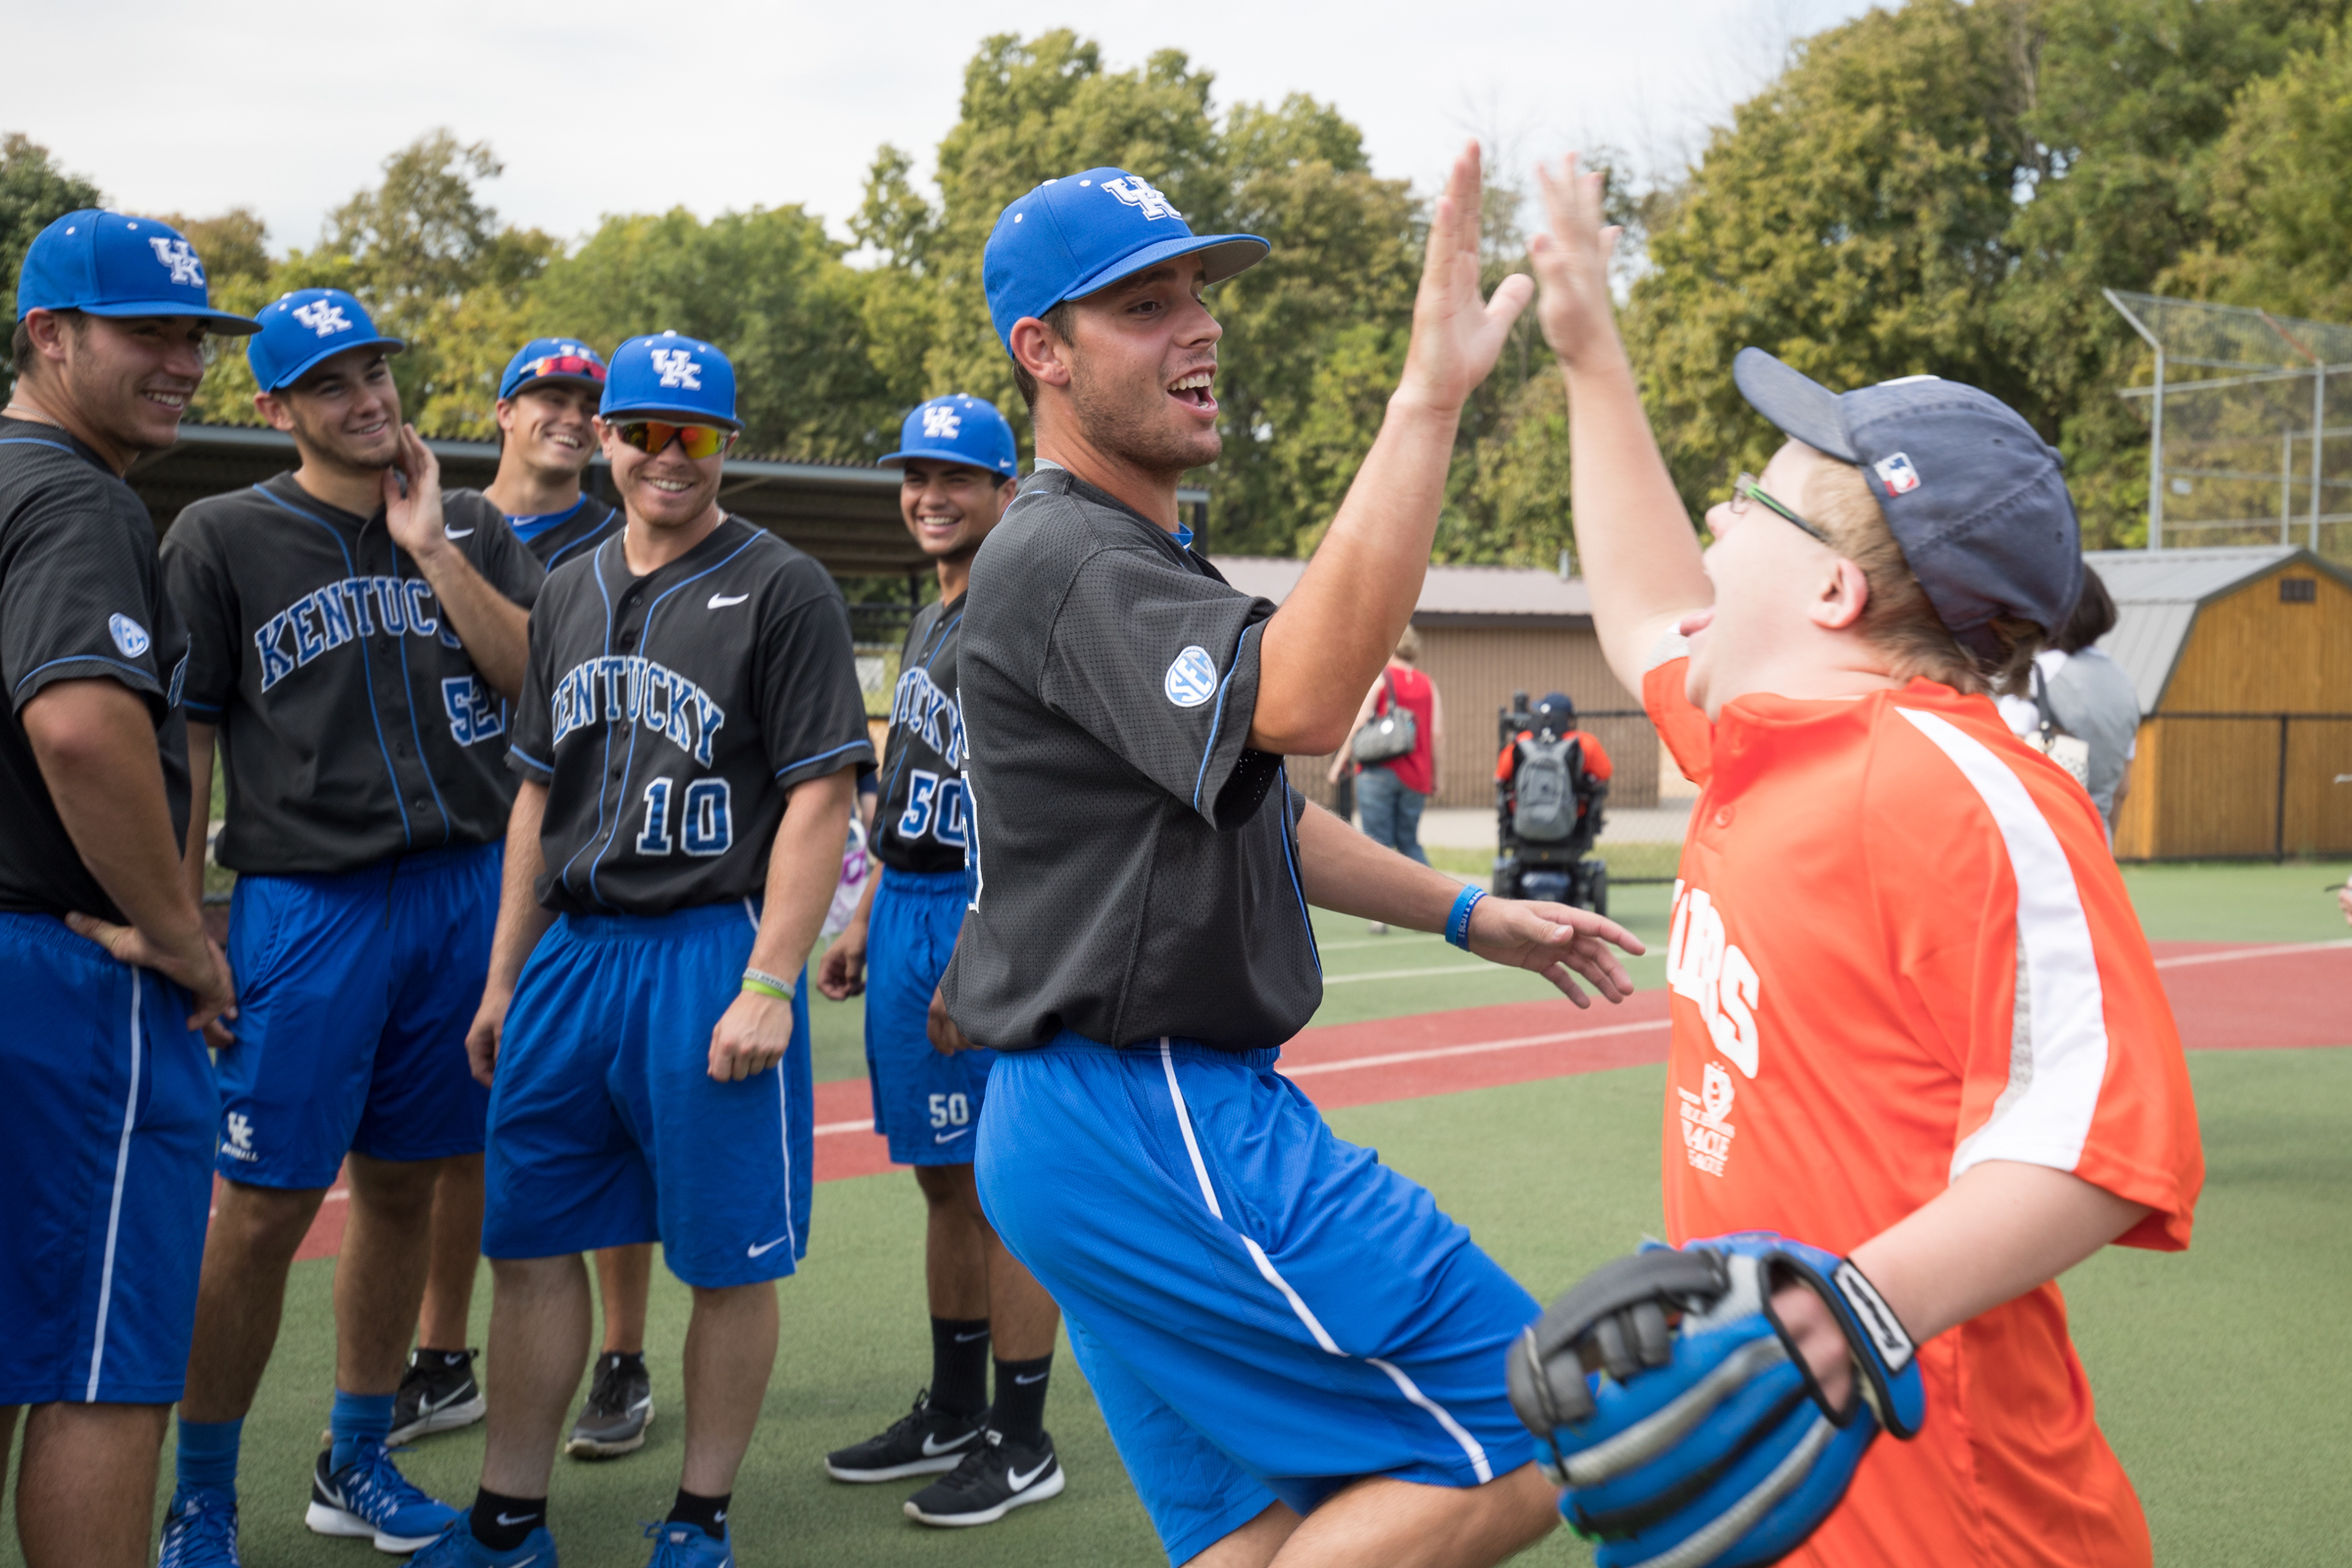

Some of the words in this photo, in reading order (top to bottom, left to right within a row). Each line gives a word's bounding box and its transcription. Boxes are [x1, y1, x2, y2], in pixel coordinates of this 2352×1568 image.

[1101, 176, 1183, 221] UK
[149, 237, 204, 288] UK
[292, 299, 353, 338] UK
[651, 349, 702, 390] UK
[922, 406, 961, 439] UK
[441, 676, 502, 747] 52
[636, 776, 733, 857] 10
[898, 768, 965, 847] 50
[227, 1110, 254, 1151] UK
[928, 1093, 969, 1128] 50
